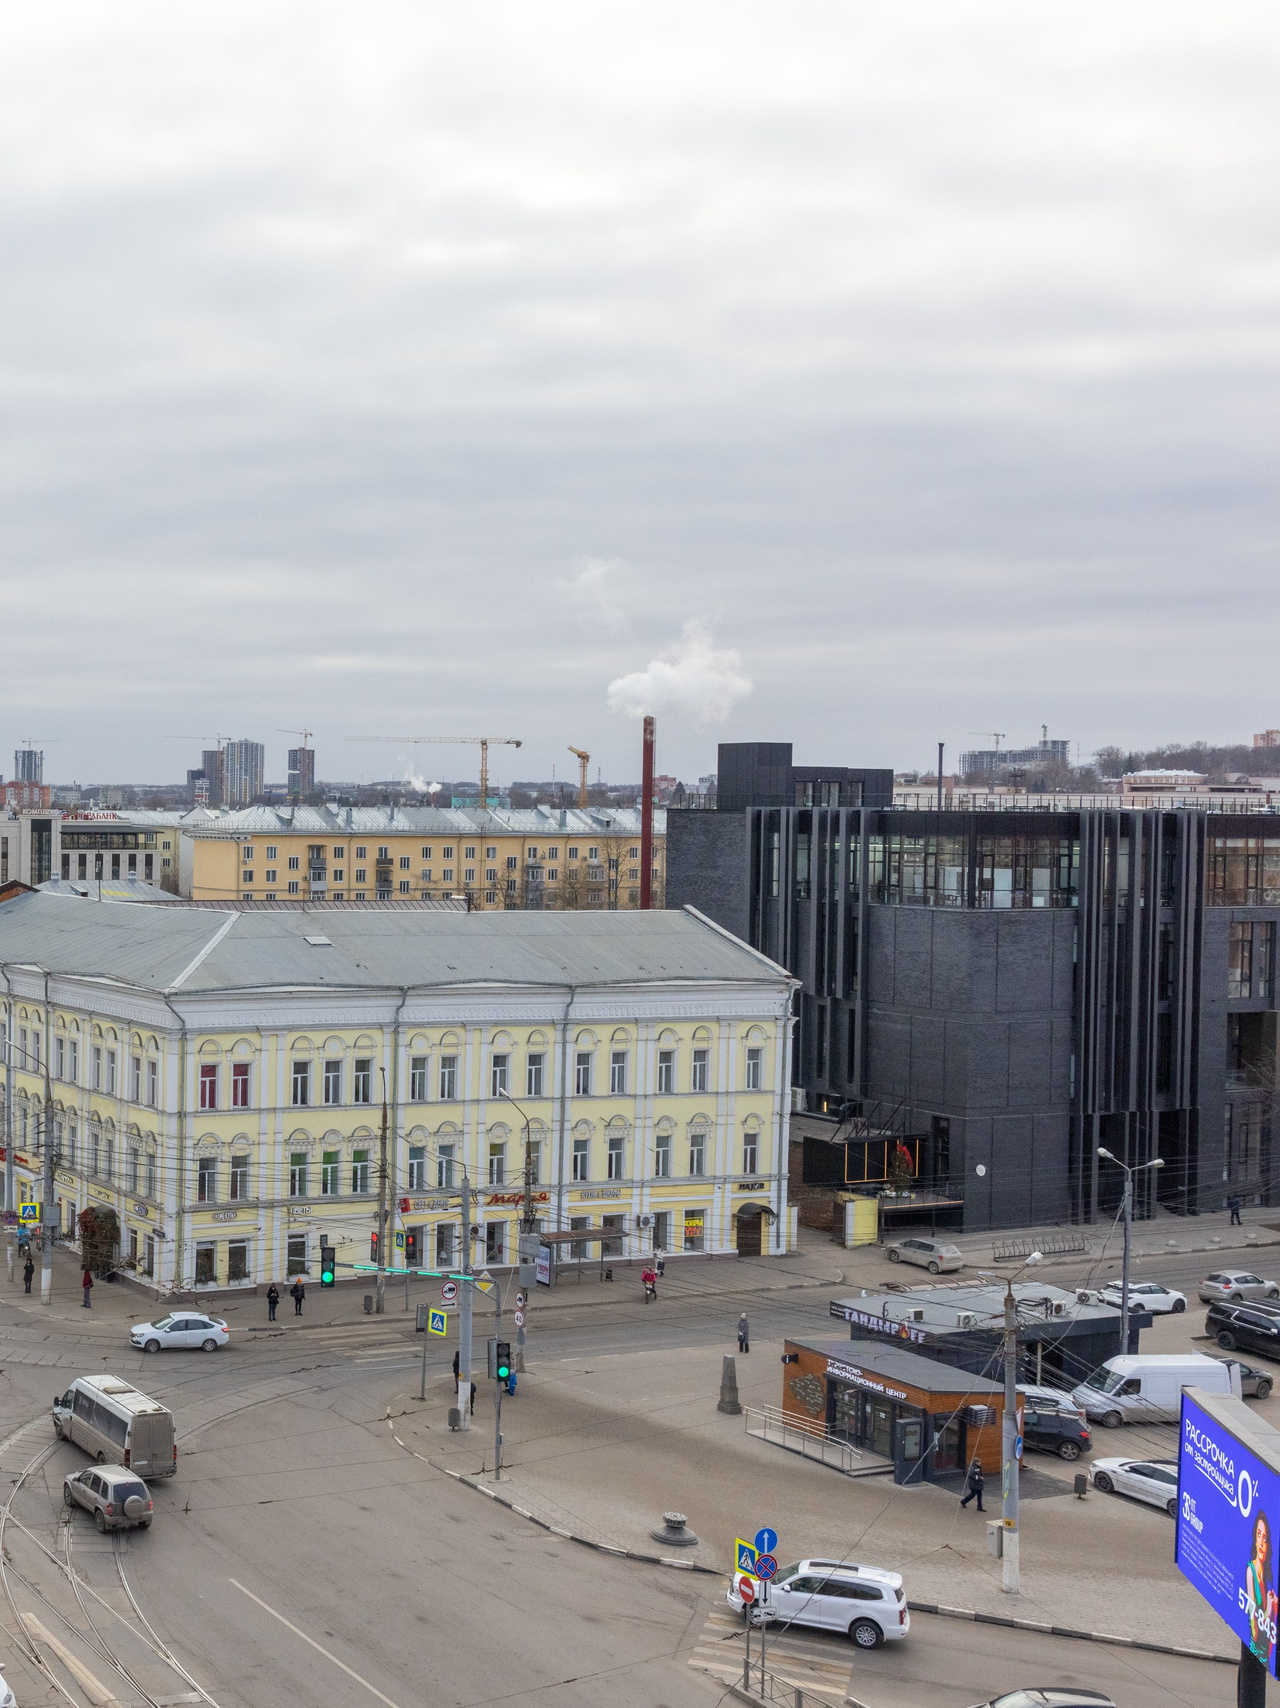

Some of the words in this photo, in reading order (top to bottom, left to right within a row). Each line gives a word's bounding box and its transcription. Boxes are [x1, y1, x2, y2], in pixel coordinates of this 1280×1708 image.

[515, 1314, 523, 1324] 40
[826, 1366, 884, 1392] ИНФОРМАЦИОННЫЙ
[886, 1387, 907, 1400] ЦЕНТР
[1184, 1442, 1194, 1457] от
[1194, 1450, 1234, 1495] застройщика
[1186, 1419, 1235, 1479] РАССРОЧКА
[1238, 1587, 1277, 1645] 577-843
